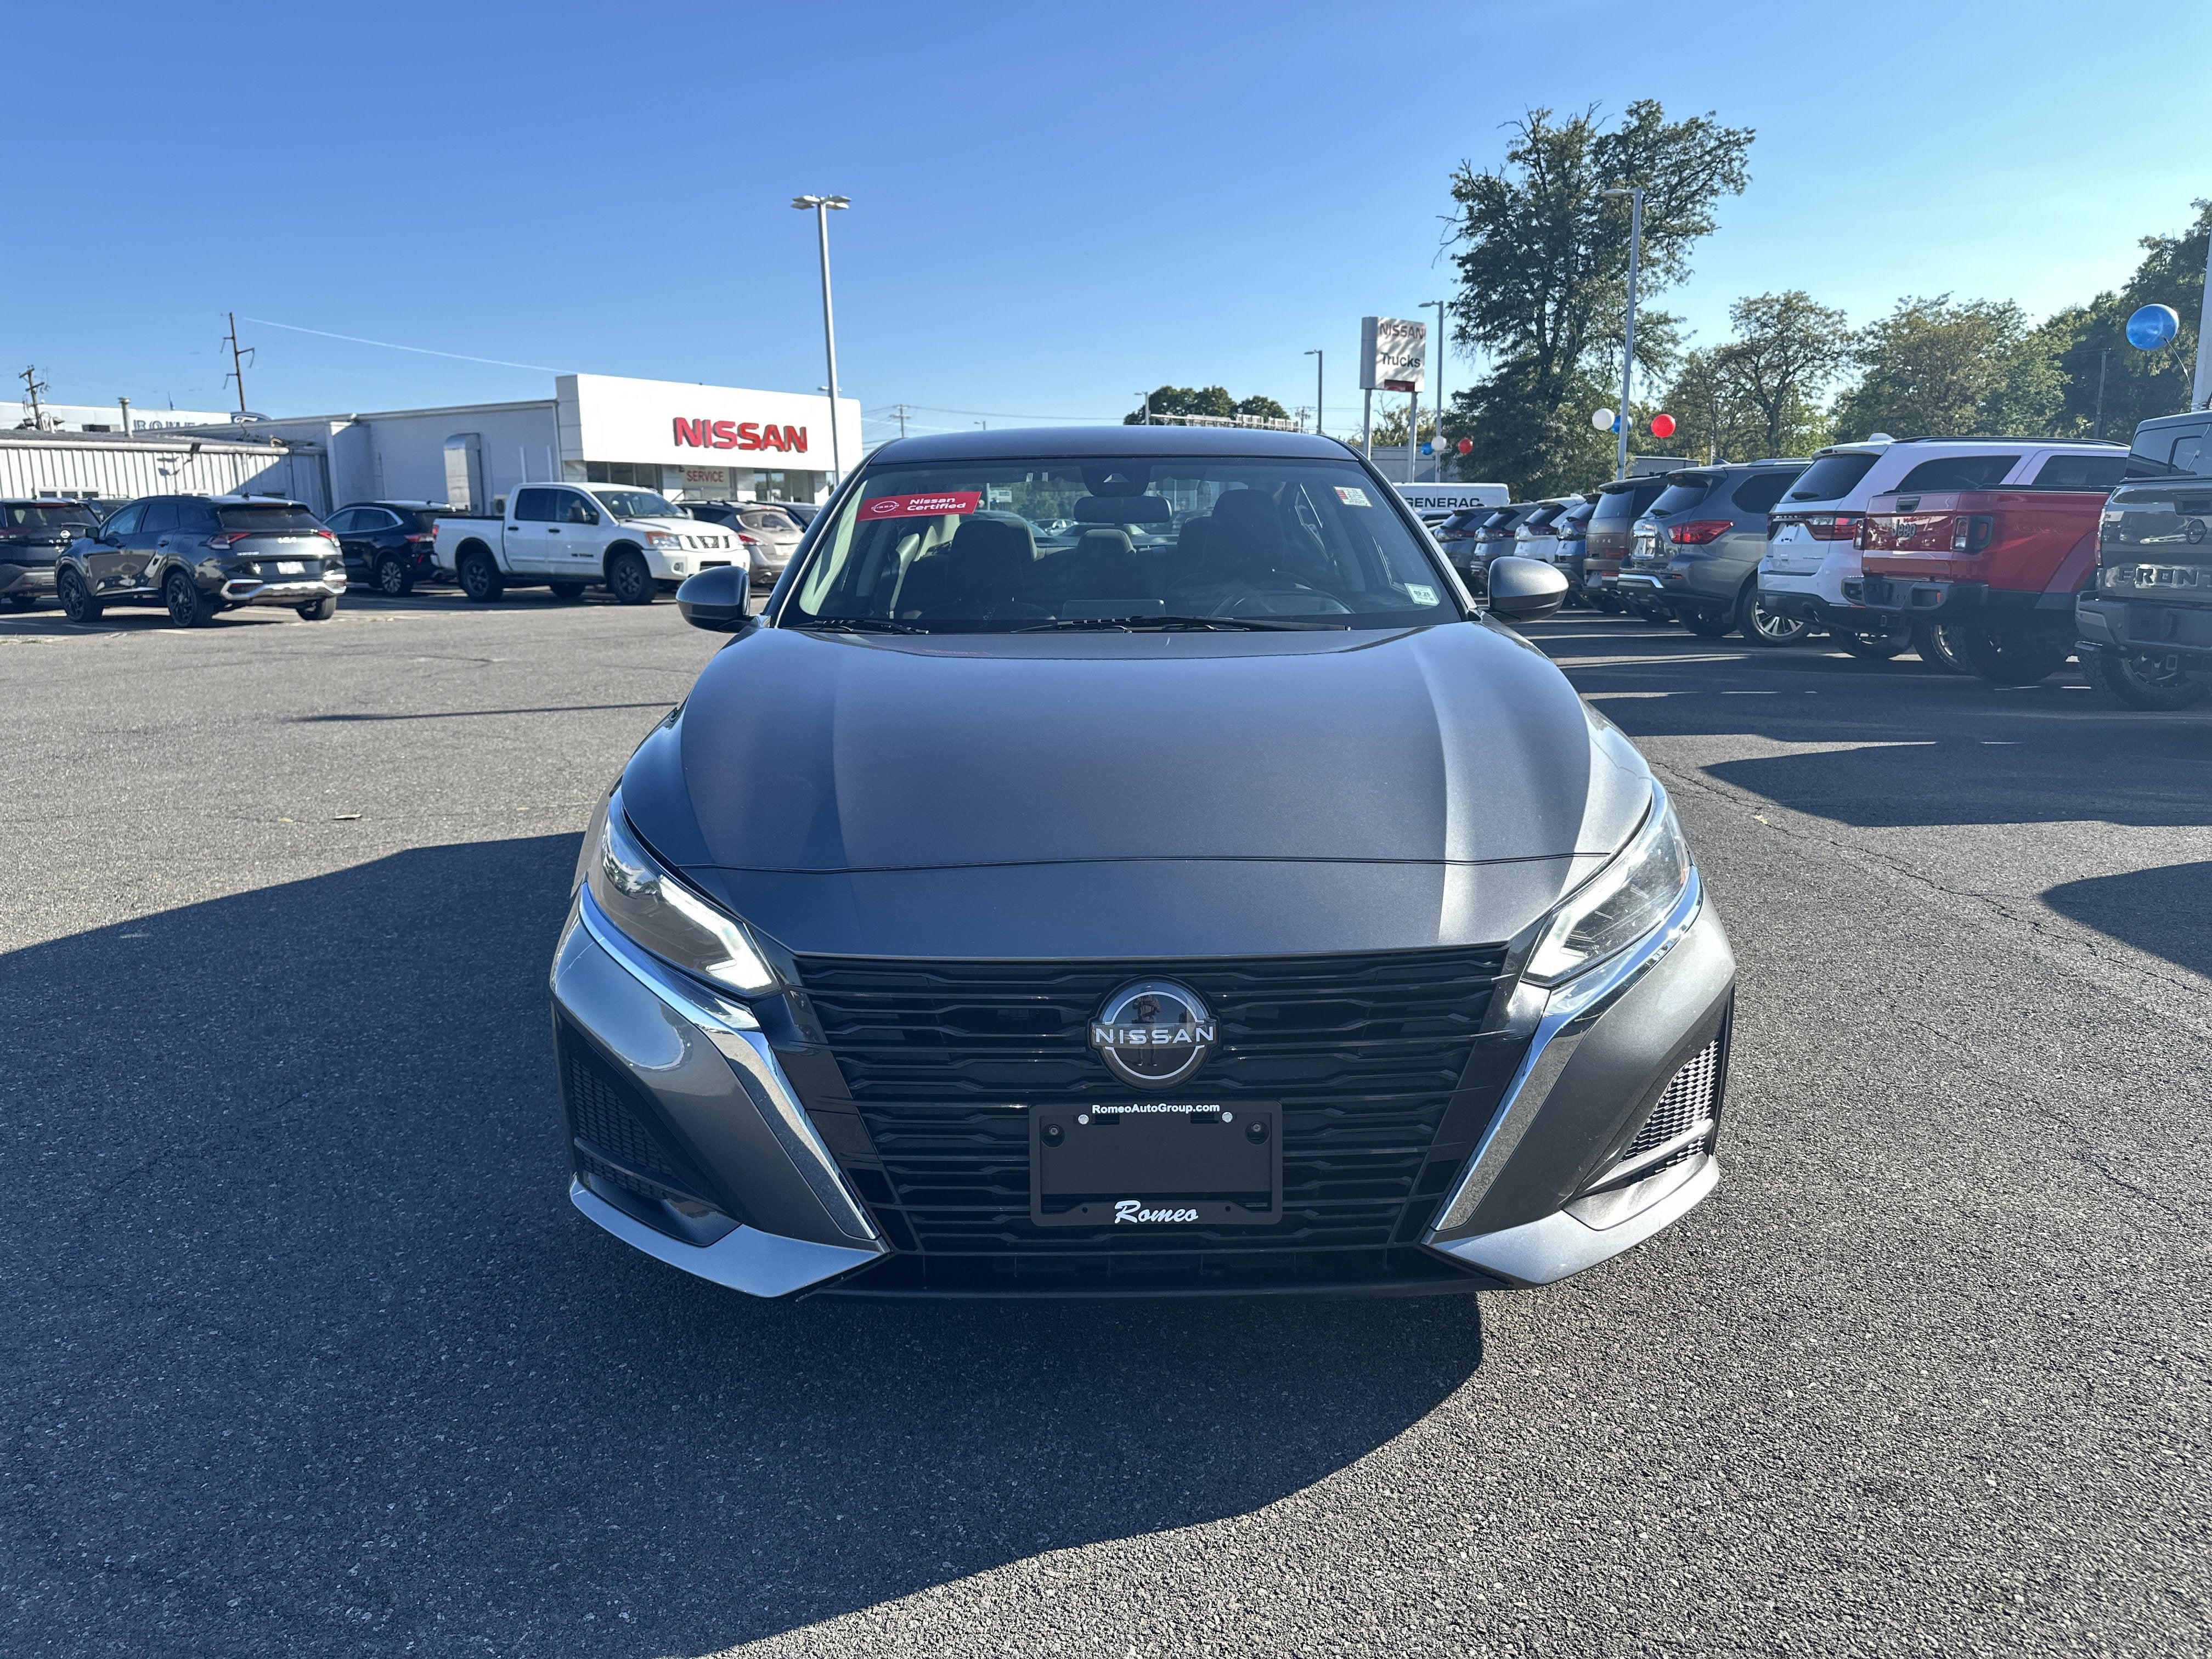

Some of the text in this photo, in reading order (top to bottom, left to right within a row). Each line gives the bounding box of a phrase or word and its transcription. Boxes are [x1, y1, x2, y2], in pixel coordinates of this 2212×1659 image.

[1379, 323, 1424, 340] NISSAN
[1380, 352, 1421, 368] Trucks
[673, 417, 808, 453] NISSAN
[686, 470, 724, 483] SERVICE
[907, 502, 967, 511] Certified
[1892, 519, 1916, 540] Jeep
[1096, 1026, 1214, 1045] NISSAN
[1092, 1104, 1220, 1114] RomeoAutoGroup.com
[1114, 1200, 1199, 1224] Romeo
